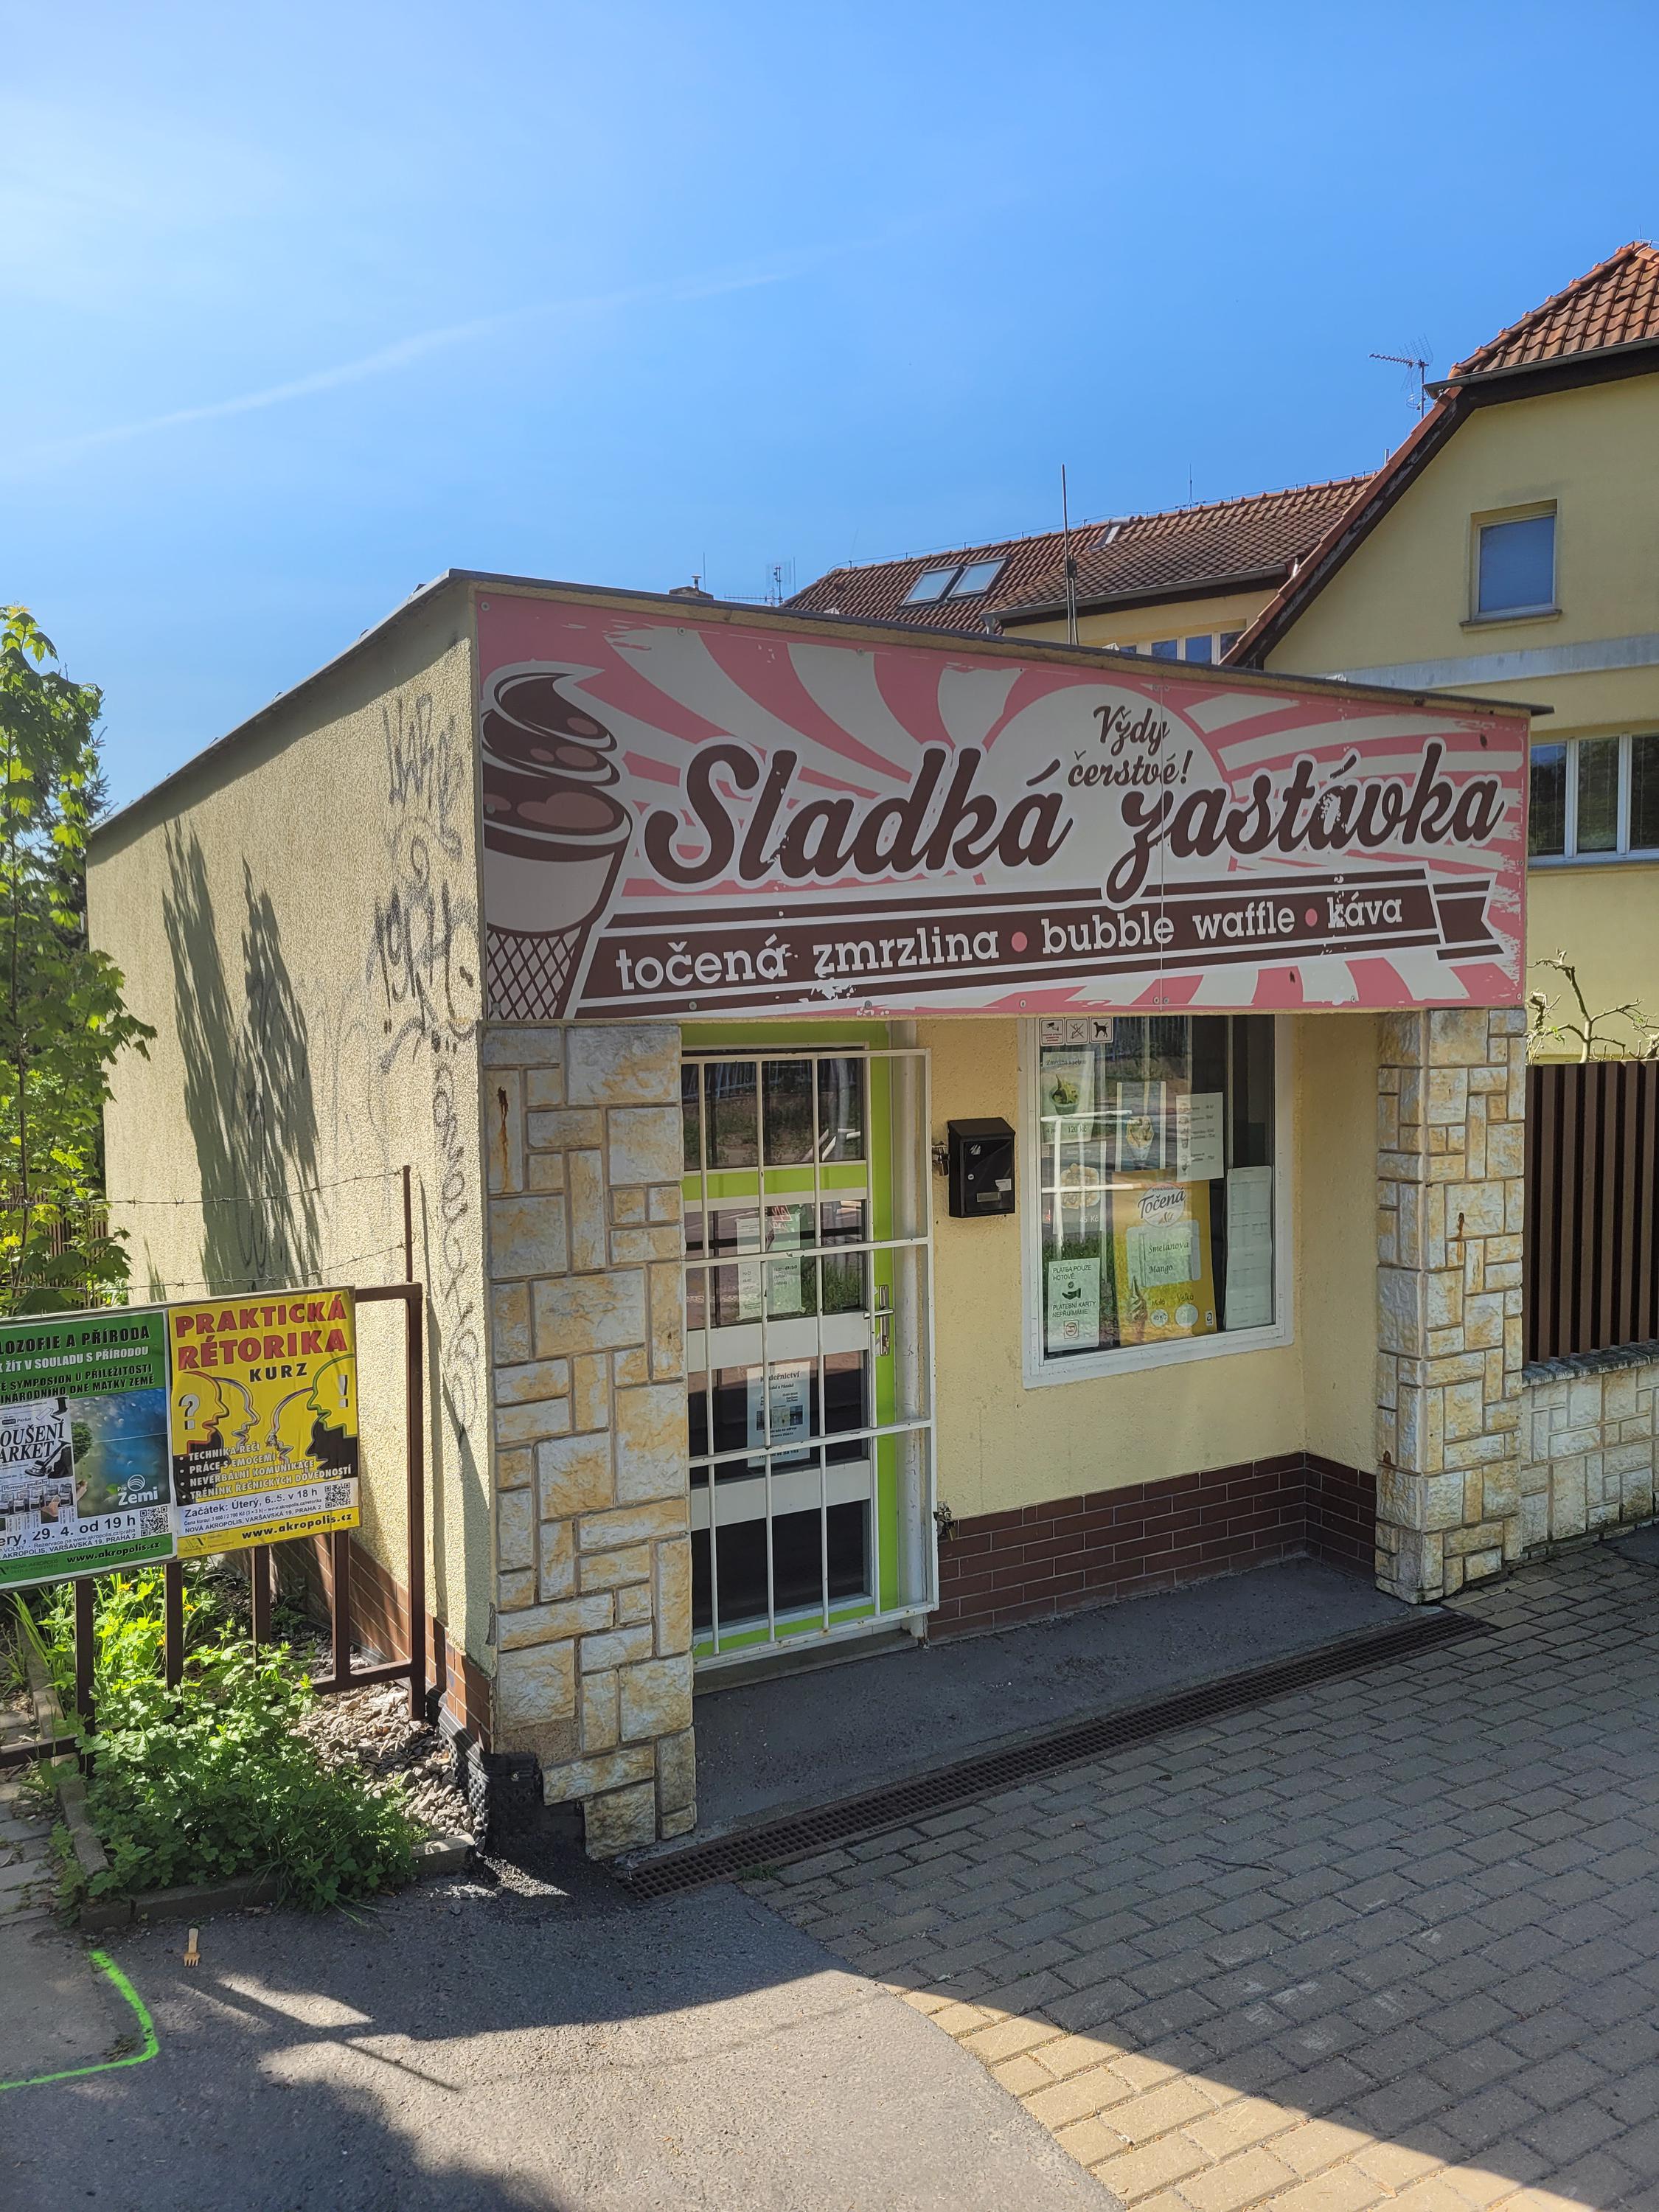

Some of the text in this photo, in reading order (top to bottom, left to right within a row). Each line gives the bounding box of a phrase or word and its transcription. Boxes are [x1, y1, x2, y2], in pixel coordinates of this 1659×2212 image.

[1093, 704, 1170, 756] Vždy
[1068, 749, 1194, 787] čerstvé!
[644, 743, 1074, 885] Sladká
[1106, 742, 1504, 904] zastávka
[616, 890, 1402, 990] točená zmrzlina bubble waffle káva
[1138, 1186, 1186, 1220] Točená
[1148, 1265, 1173, 1274] Mango
[175, 1294, 347, 1338] PRAKTICKÁ
[66, 1334, 77, 1349] A
[81, 1326, 150, 1346] PŘÍRODA
[178, 1328, 348, 1371] RÉTORIKA
[6, 1360, 22, 1373] ŽÍT
[24, 1360, 32, 1371] V
[35, 1353, 84, 1370] SOULADU
[86, 1352, 94, 1363] S
[96, 1346, 149, 1361] PŘÍRODOU
[249, 1363, 307, 1382] KURZ
[10, 1374, 72, 1391] SYMPOSION
[76, 1373, 83, 1382] U
[86, 1364, 153, 1380] PŘÍLEŽITOSTI
[70, 1383, 90, 1395] DNE
[93, 1377, 125, 1391] MATKY
[129, 1374, 154, 1388] ZEMĚ
[760, 1371, 800, 1382] Kdeřnictví
[189, 1443, 260, 1461] TECHNIKA ŘEČI
[189, 1461, 221, 1475] PRÁCE
[231, 1455, 276, 1467] EMOCEMI
[189, 1459, 316, 1487] NEVERBÁLNÍ KOMUNIKACE
[189, 1464, 352, 1500] TRÉNINK ŘEČNICKÝCH DOVEDNOSTÍ
[118, 1487, 159, 1506] Zemi
[184, 1503, 228, 1517] Začátek:
[232, 1495, 262, 1509] Úterý,
[298, 1489, 308, 1498] 18
[311, 1488, 317, 1496] h
[32, 1528, 55, 1542] 29.
[60, 1526, 74, 1537] 4.
[80, 1520, 99, 1534] od
[104, 1517, 122, 1530] 19
[127, 1514, 136, 1527] h
[185, 1526, 204, 1534] NOVÁ
[205, 1520, 244, 1531] AKROPOLIS,
[245, 1512, 284, 1524] VARŠAVSKÁ
[295, 1506, 317, 1514] PRAHA
[242, 1513, 352, 1539] www.akropolis.cz
[49, 1540, 93, 1553] VARŠAVSKÁ
[105, 1534, 132, 1543] PRAHA
[66, 1542, 160, 1564] www.akropolis.cz
